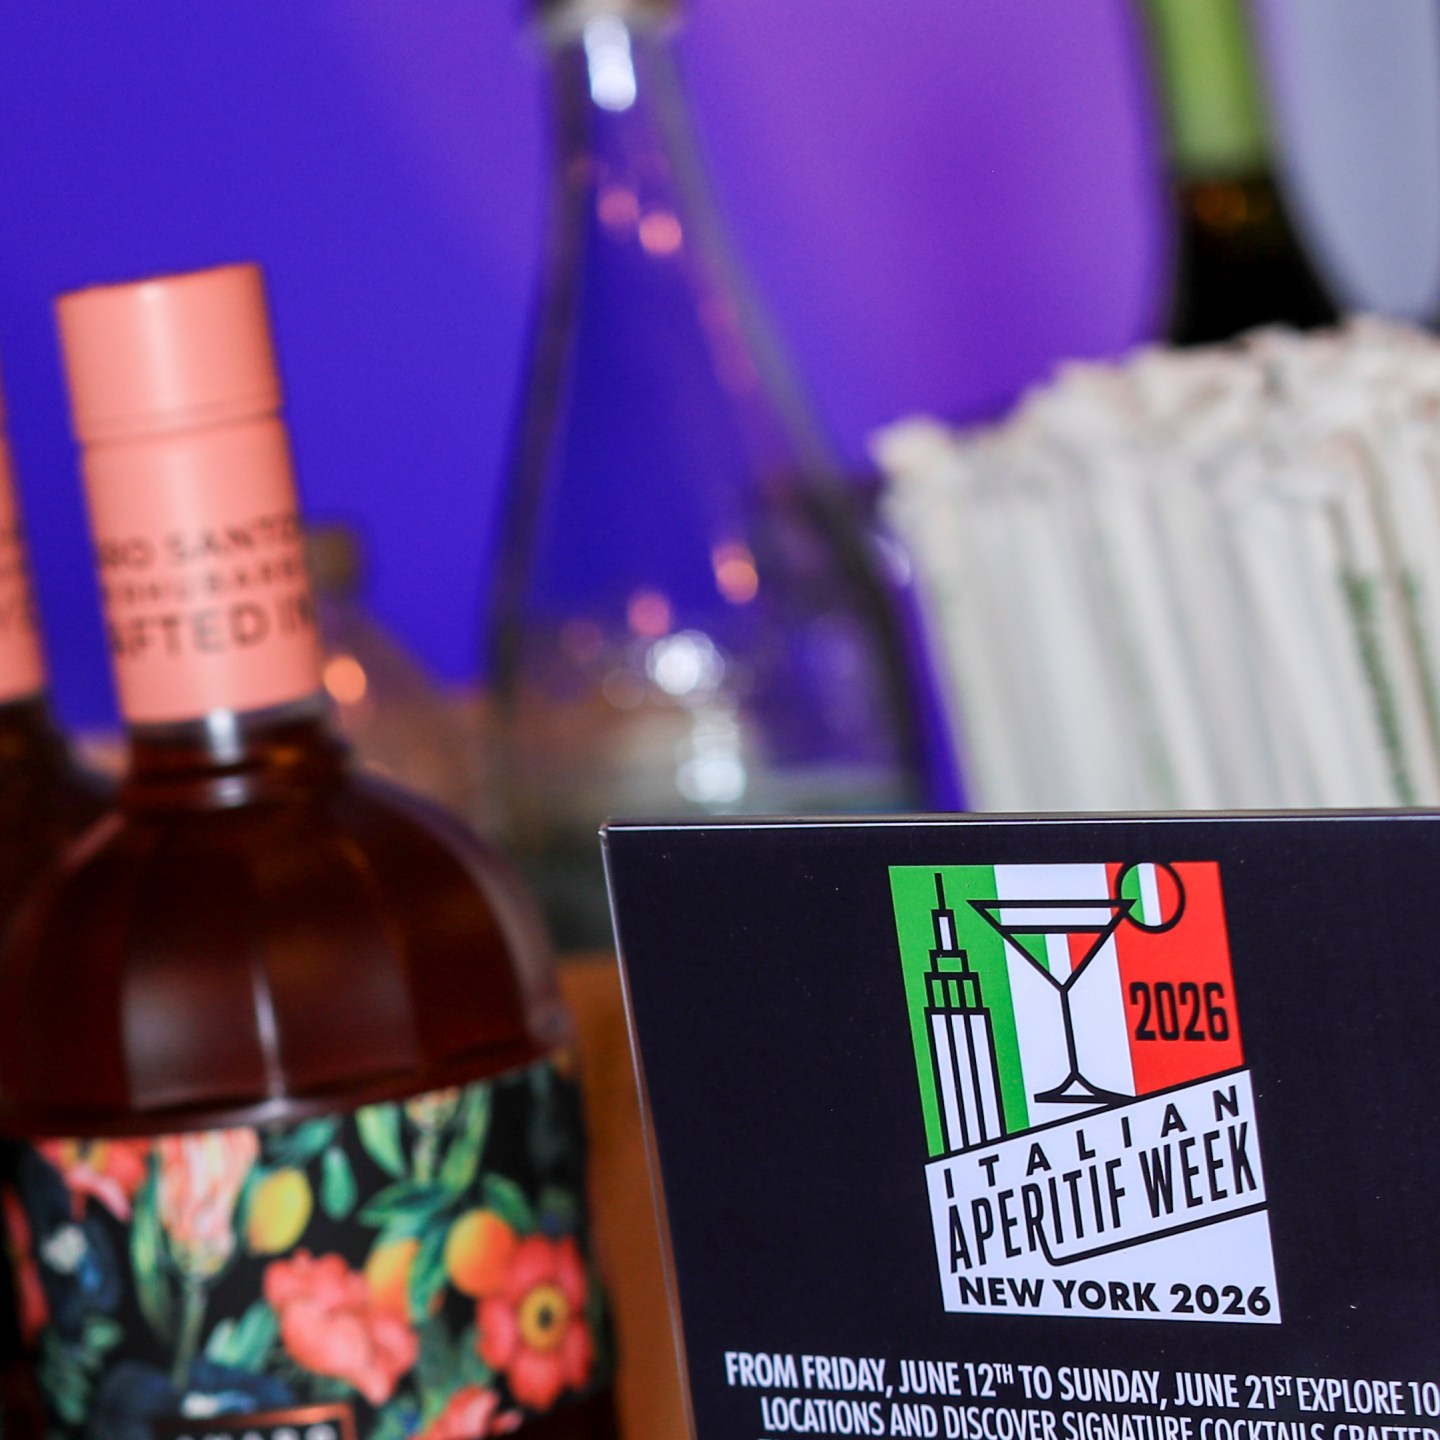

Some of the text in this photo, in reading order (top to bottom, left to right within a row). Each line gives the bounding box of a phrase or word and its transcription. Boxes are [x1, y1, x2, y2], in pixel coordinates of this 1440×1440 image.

[1130, 981, 1230, 1042] 2026
[944, 1085, 1239, 1198] ITALIAN
[949, 1121, 1257, 1274] APERITIF WEEK
[958, 1276, 1271, 1316] NEW YORK 2026
[724, 1351, 798, 1388] FROM
[801, 1355, 894, 1399] FRIDAY,
[898, 1359, 962, 1396] JUNE
[963, 1362, 1015, 1397] 12TH
[1018, 1365, 1053, 1400] TO
[1058, 1366, 1167, 1411] SUNDAY,
[1174, 1371, 1240, 1408] JUNE
[1244, 1375, 1292, 1410] 21ST
[1296, 1377, 1405, 1416] EXPLORE
[760, 1396, 885, 1437] LOCATIONS
[890, 1403, 938, 1438] AND
